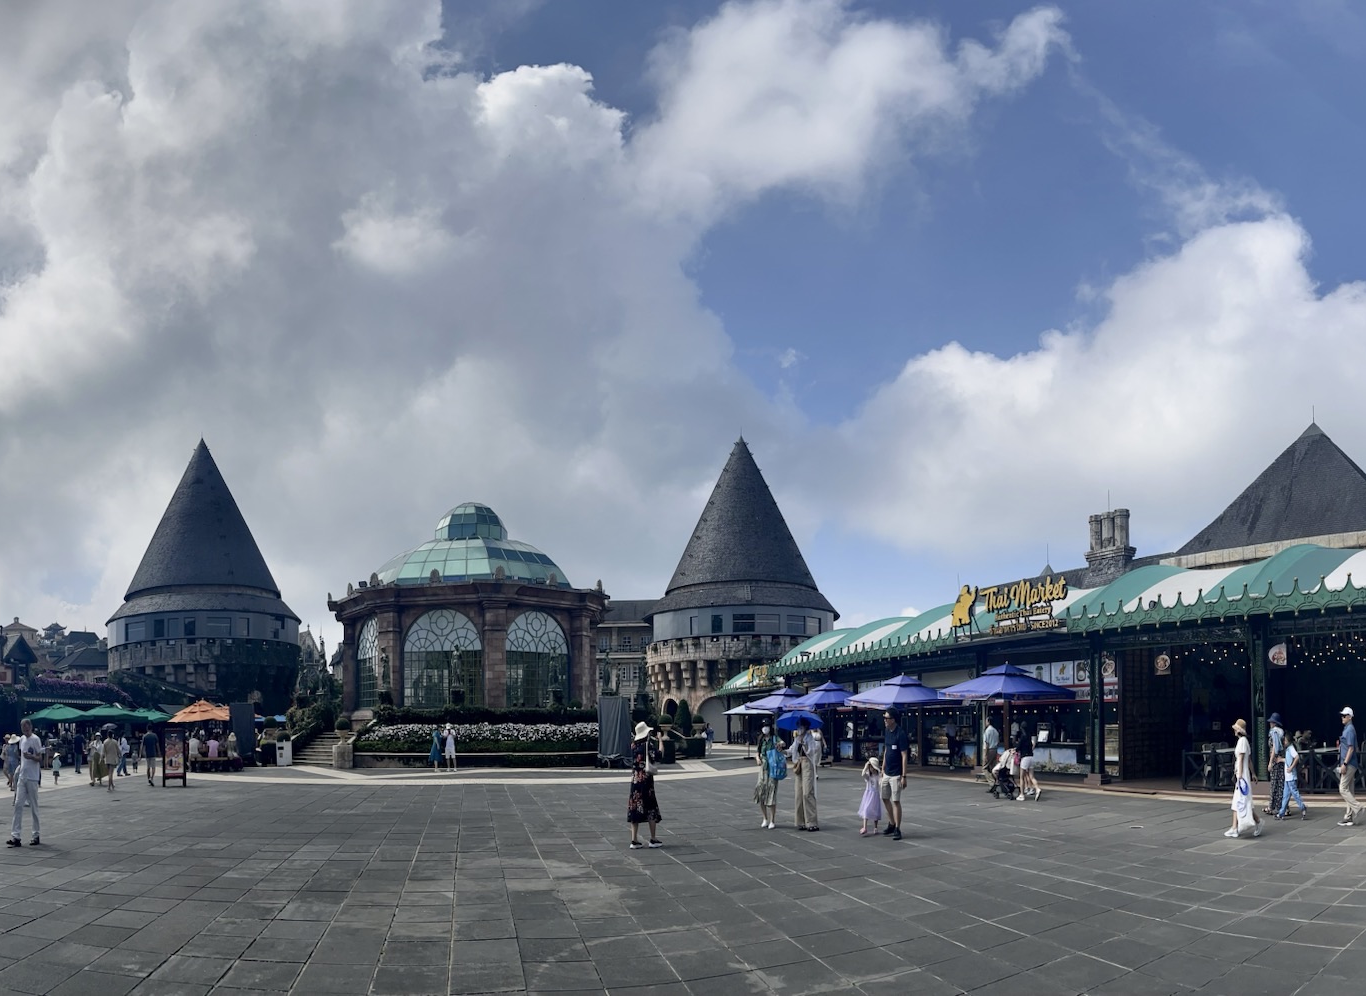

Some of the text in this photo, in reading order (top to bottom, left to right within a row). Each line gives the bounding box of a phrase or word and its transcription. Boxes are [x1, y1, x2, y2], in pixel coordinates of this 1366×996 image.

[979, 576, 1067, 612] Thai Market
[1020, 609, 1032, 617] Thai
[1033, 606, 1052, 615] Eatery
